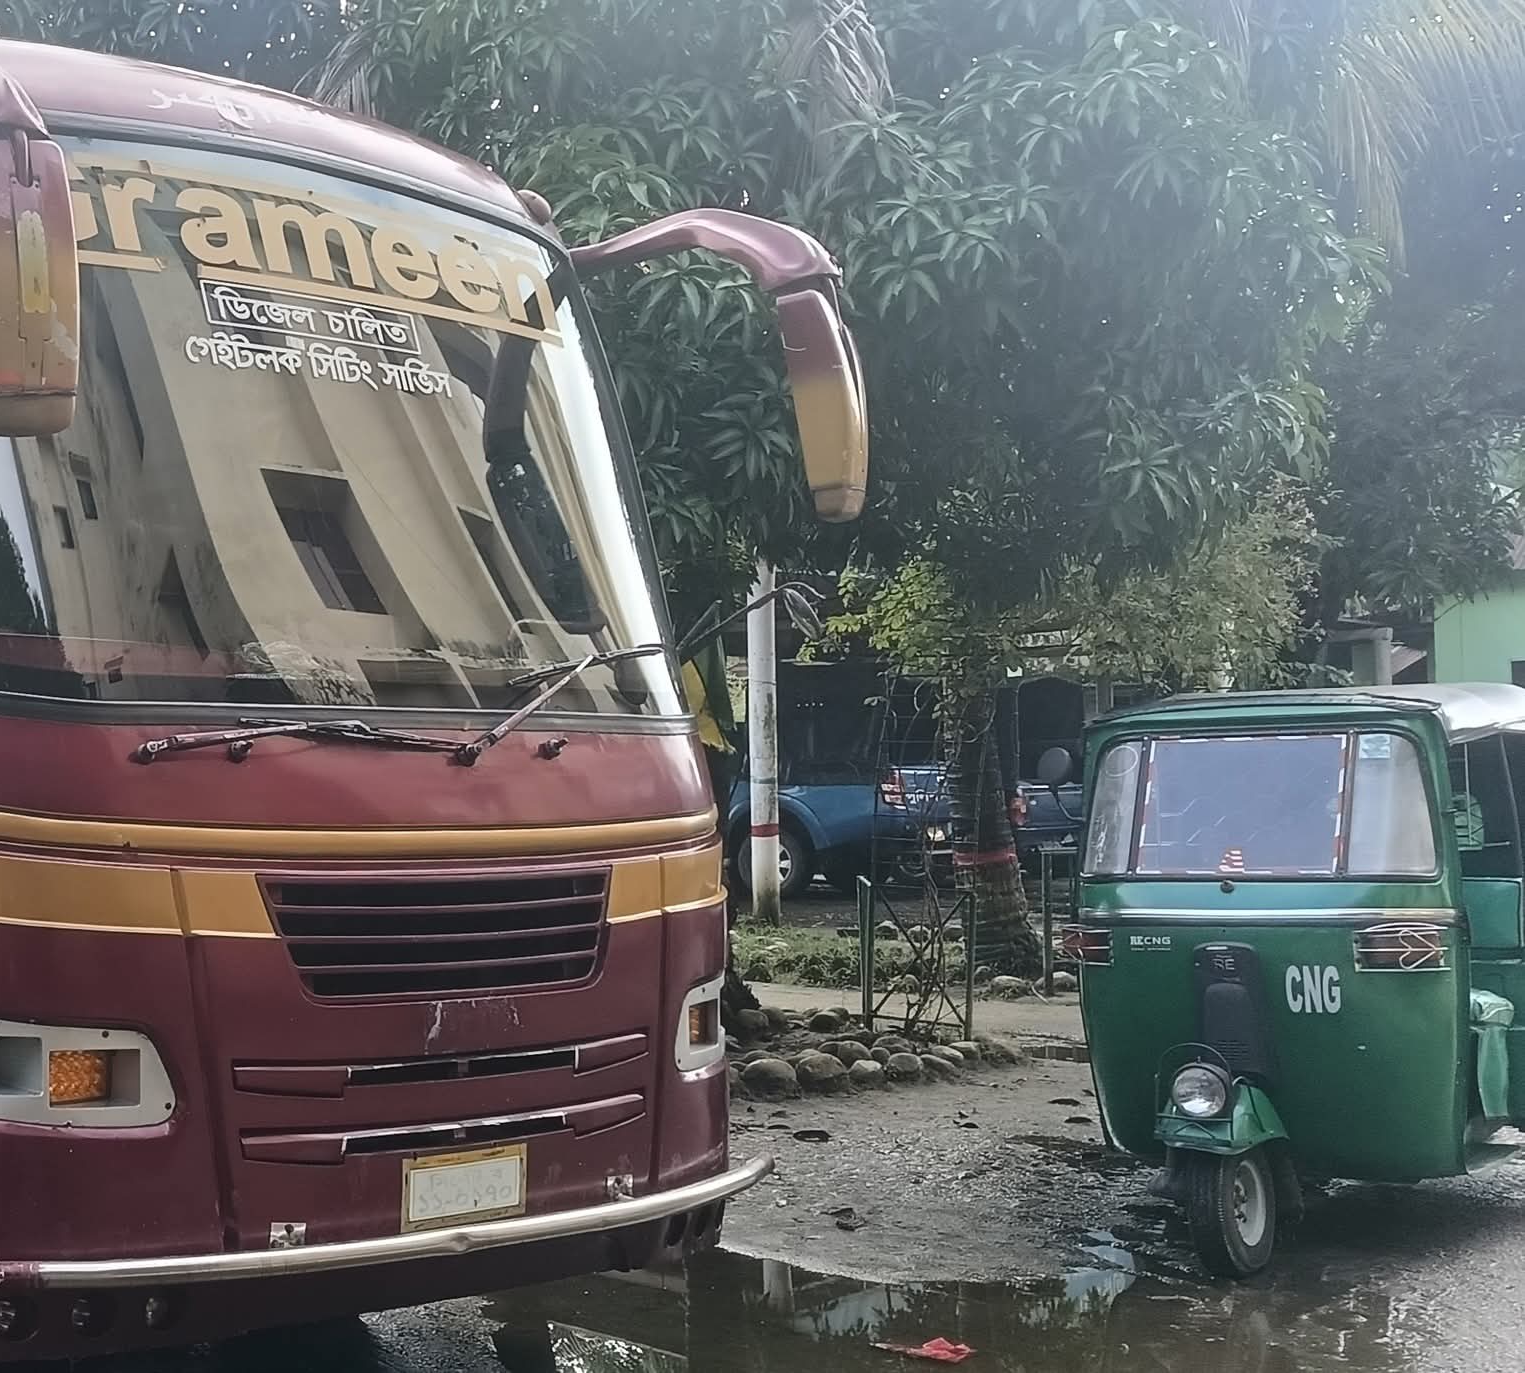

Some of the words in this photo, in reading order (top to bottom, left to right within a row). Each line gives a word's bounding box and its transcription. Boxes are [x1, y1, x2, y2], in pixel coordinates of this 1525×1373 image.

[210, 286, 316, 333] ডিজেল
[322, 307, 410, 345] চালিত
[185, 331, 303, 376] গেইটলক
[307, 342, 379, 391] সিটিং
[377, 357, 453, 399] সার্ভিস
[1285, 965, 1341, 1013] CNG
